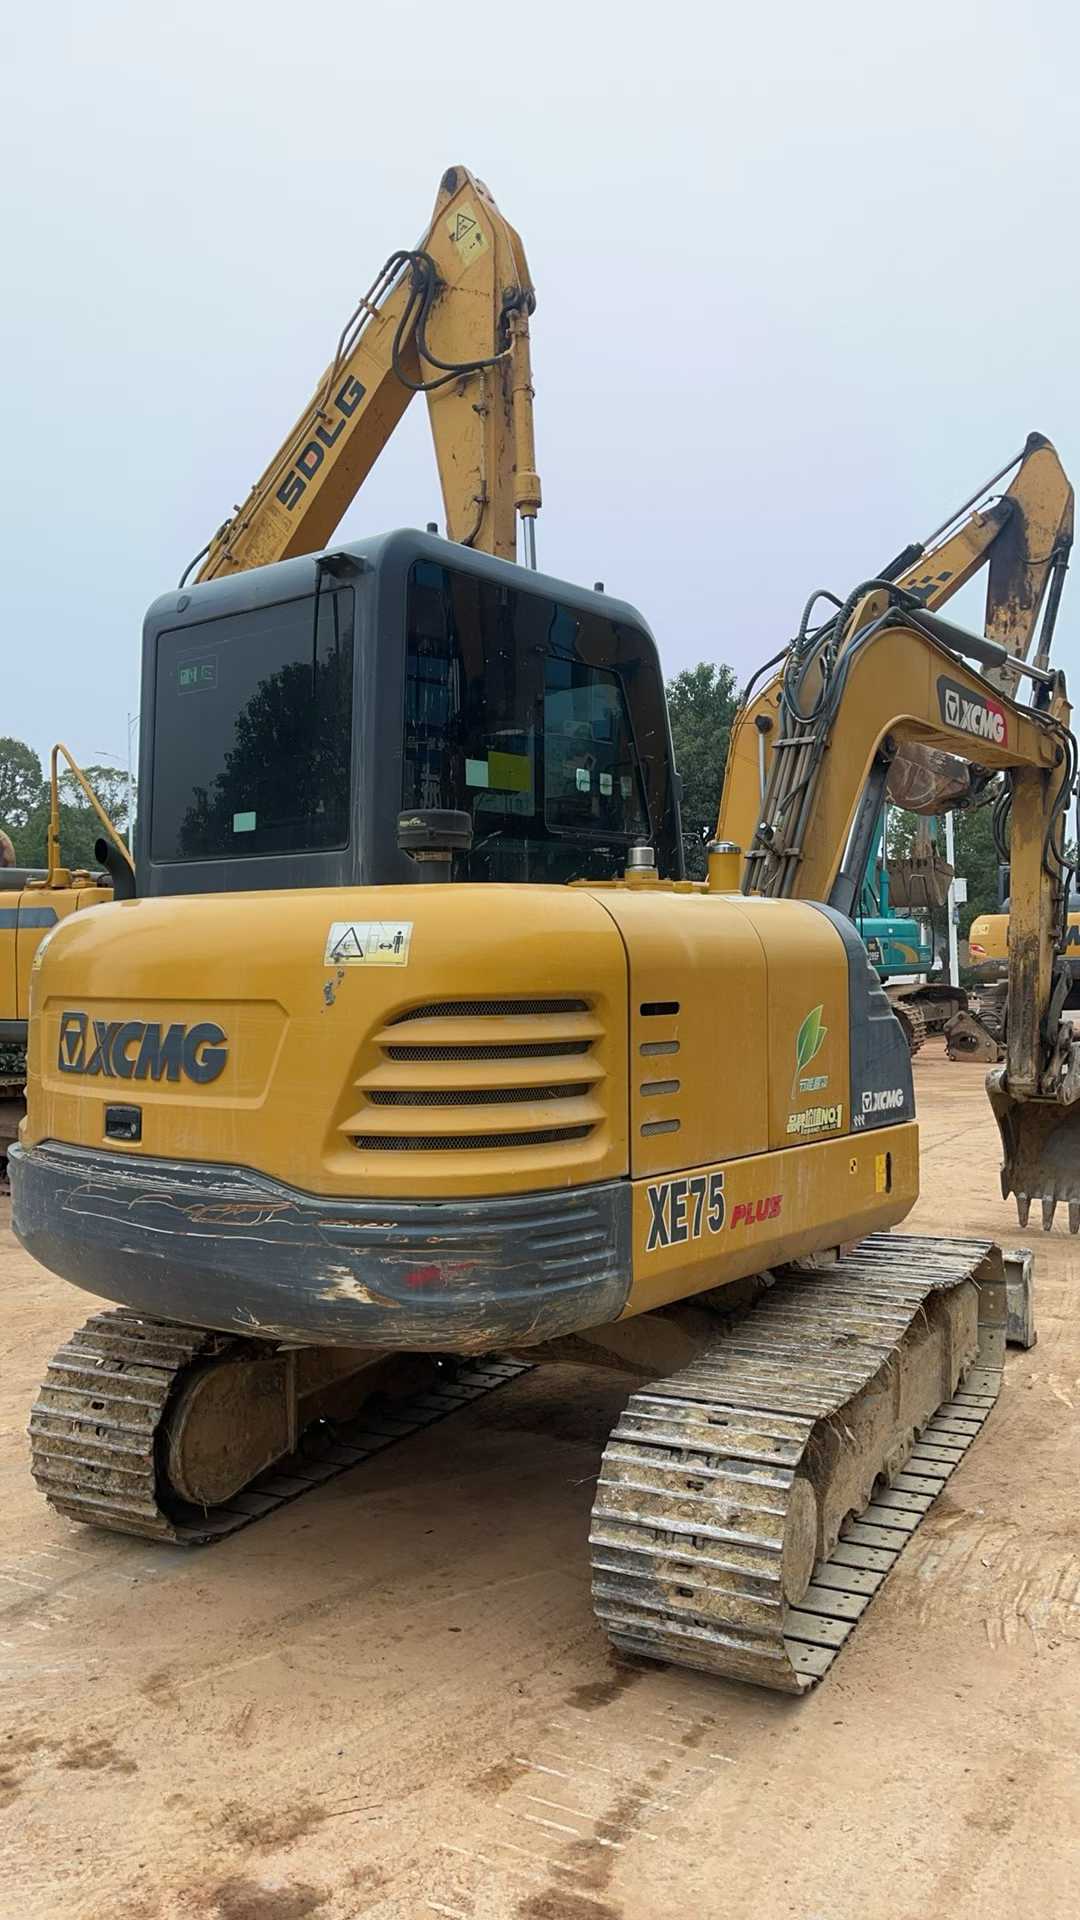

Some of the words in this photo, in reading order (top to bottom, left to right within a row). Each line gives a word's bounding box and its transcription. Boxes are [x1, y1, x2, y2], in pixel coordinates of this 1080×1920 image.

[275, 374, 367, 512] SDLG
[960, 699, 1005, 743] XCMG
[84, 1020, 230, 1085] XCMG
[872, 1089, 904, 1111] XCMG
[646, 1171, 726, 1253] XE75
[730, 1193, 784, 1230] PLUS
